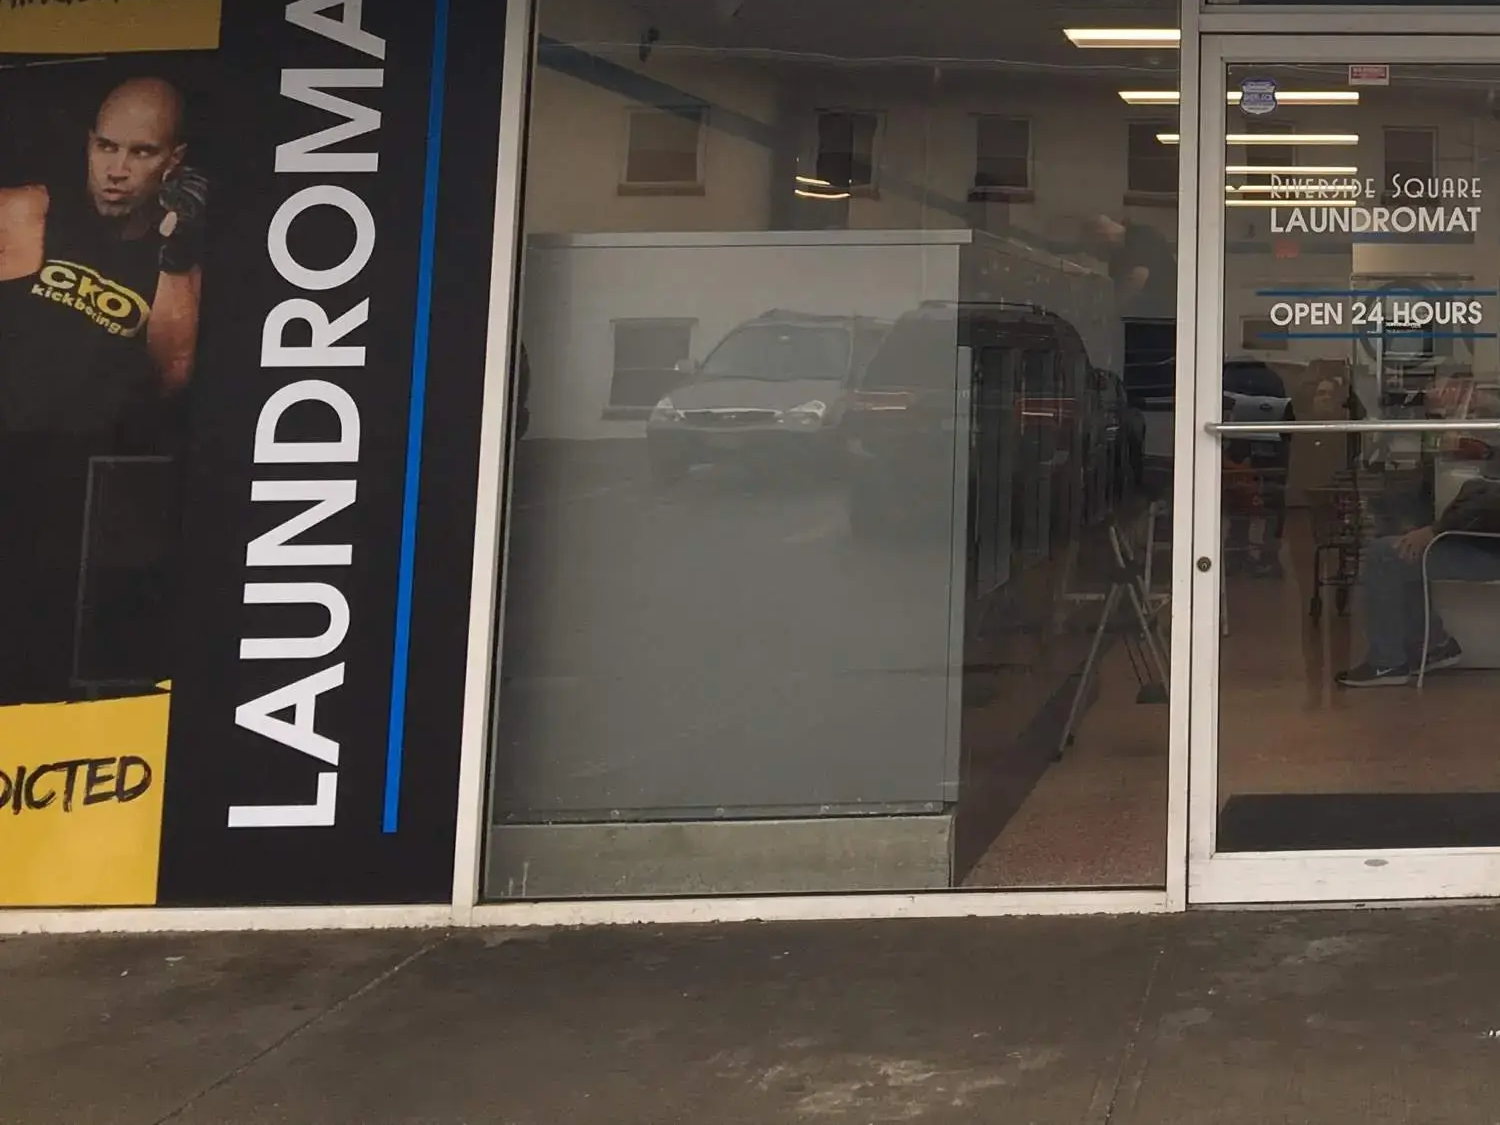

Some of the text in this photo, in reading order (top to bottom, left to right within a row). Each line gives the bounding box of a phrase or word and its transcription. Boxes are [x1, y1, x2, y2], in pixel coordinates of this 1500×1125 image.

[1270, 206, 1482, 233] LAUNDROMAT
[38, 264, 133, 318] CKO
[1270, 301, 1483, 326] OPEN 24 HOURS
